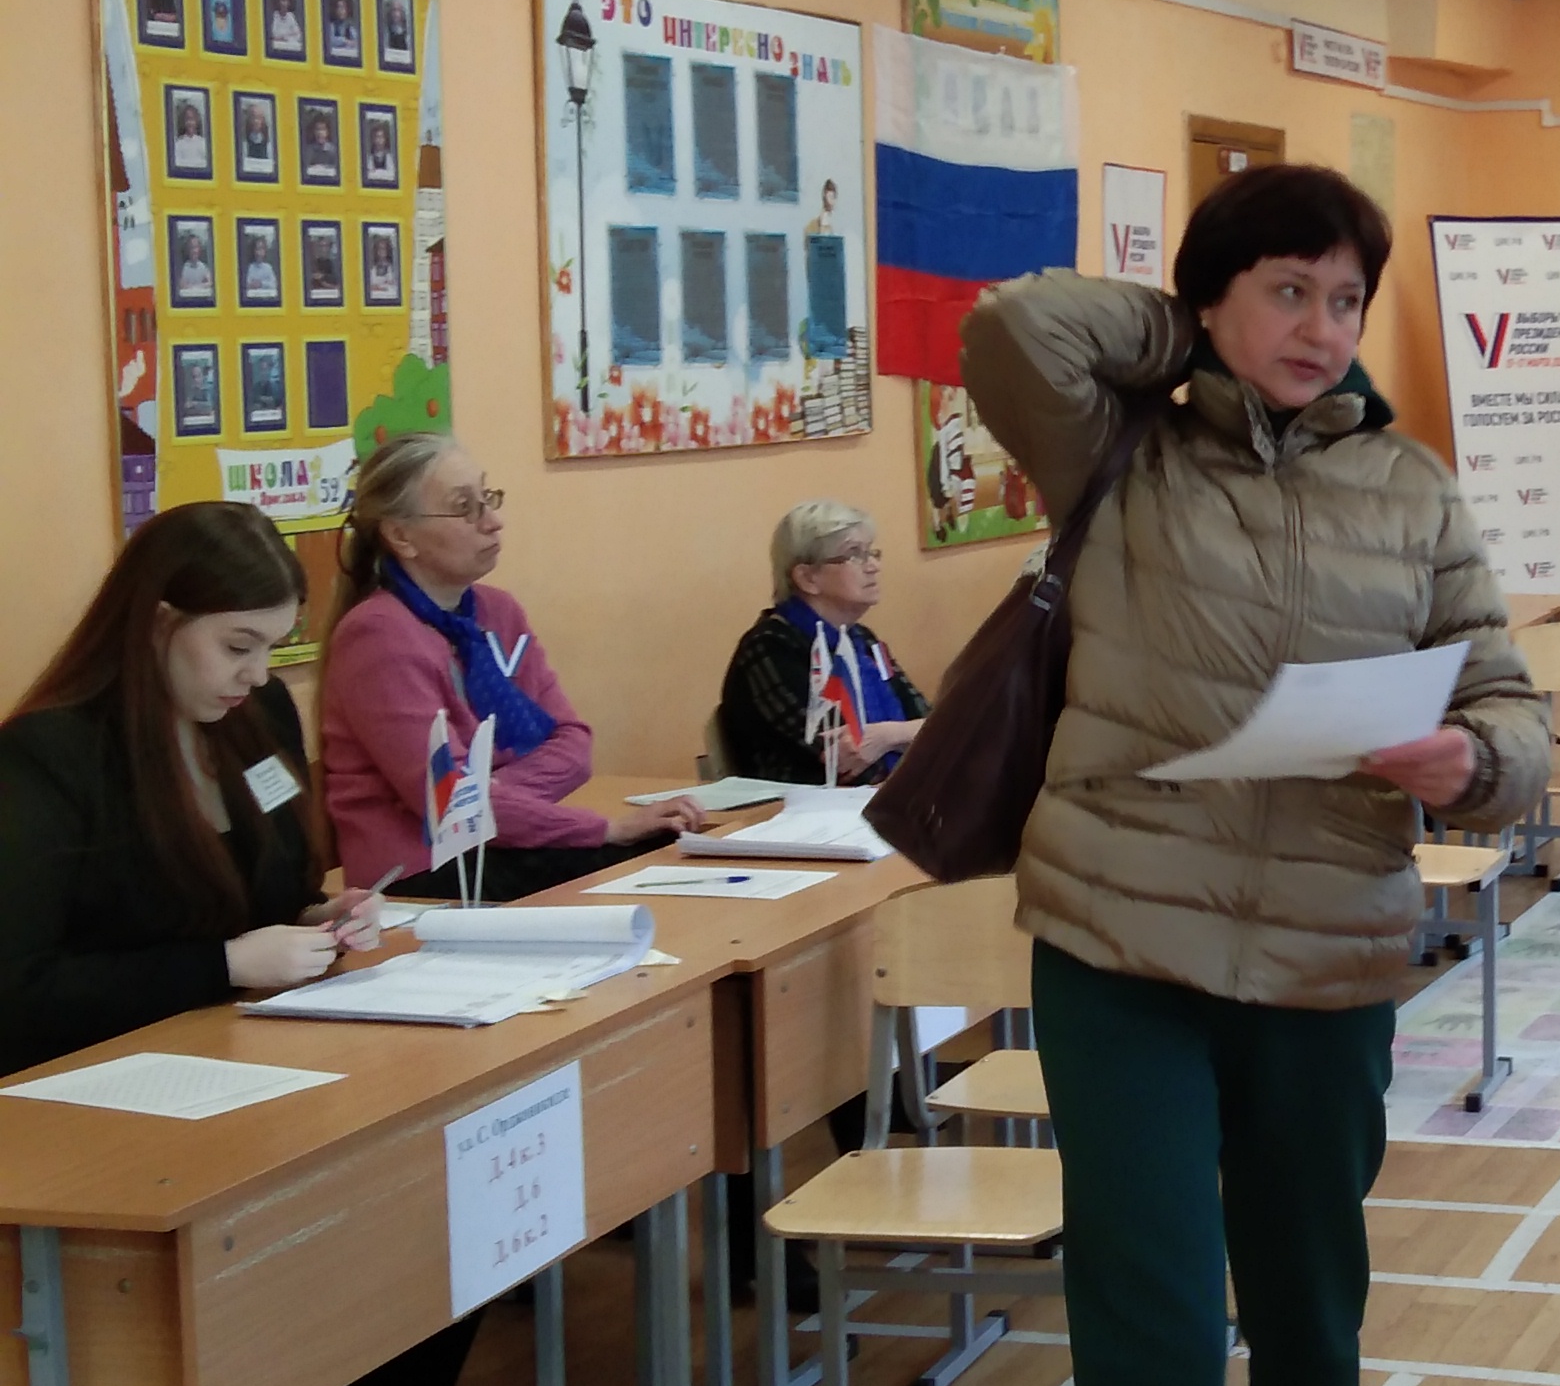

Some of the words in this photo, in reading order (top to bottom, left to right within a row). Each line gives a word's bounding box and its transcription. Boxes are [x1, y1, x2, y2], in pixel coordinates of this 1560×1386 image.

[662, 15, 784, 62] ИНТЕРЕСНО
[789, 51, 852, 86] ЗНАТЬ
[227, 460, 309, 492] ШКОЛА
